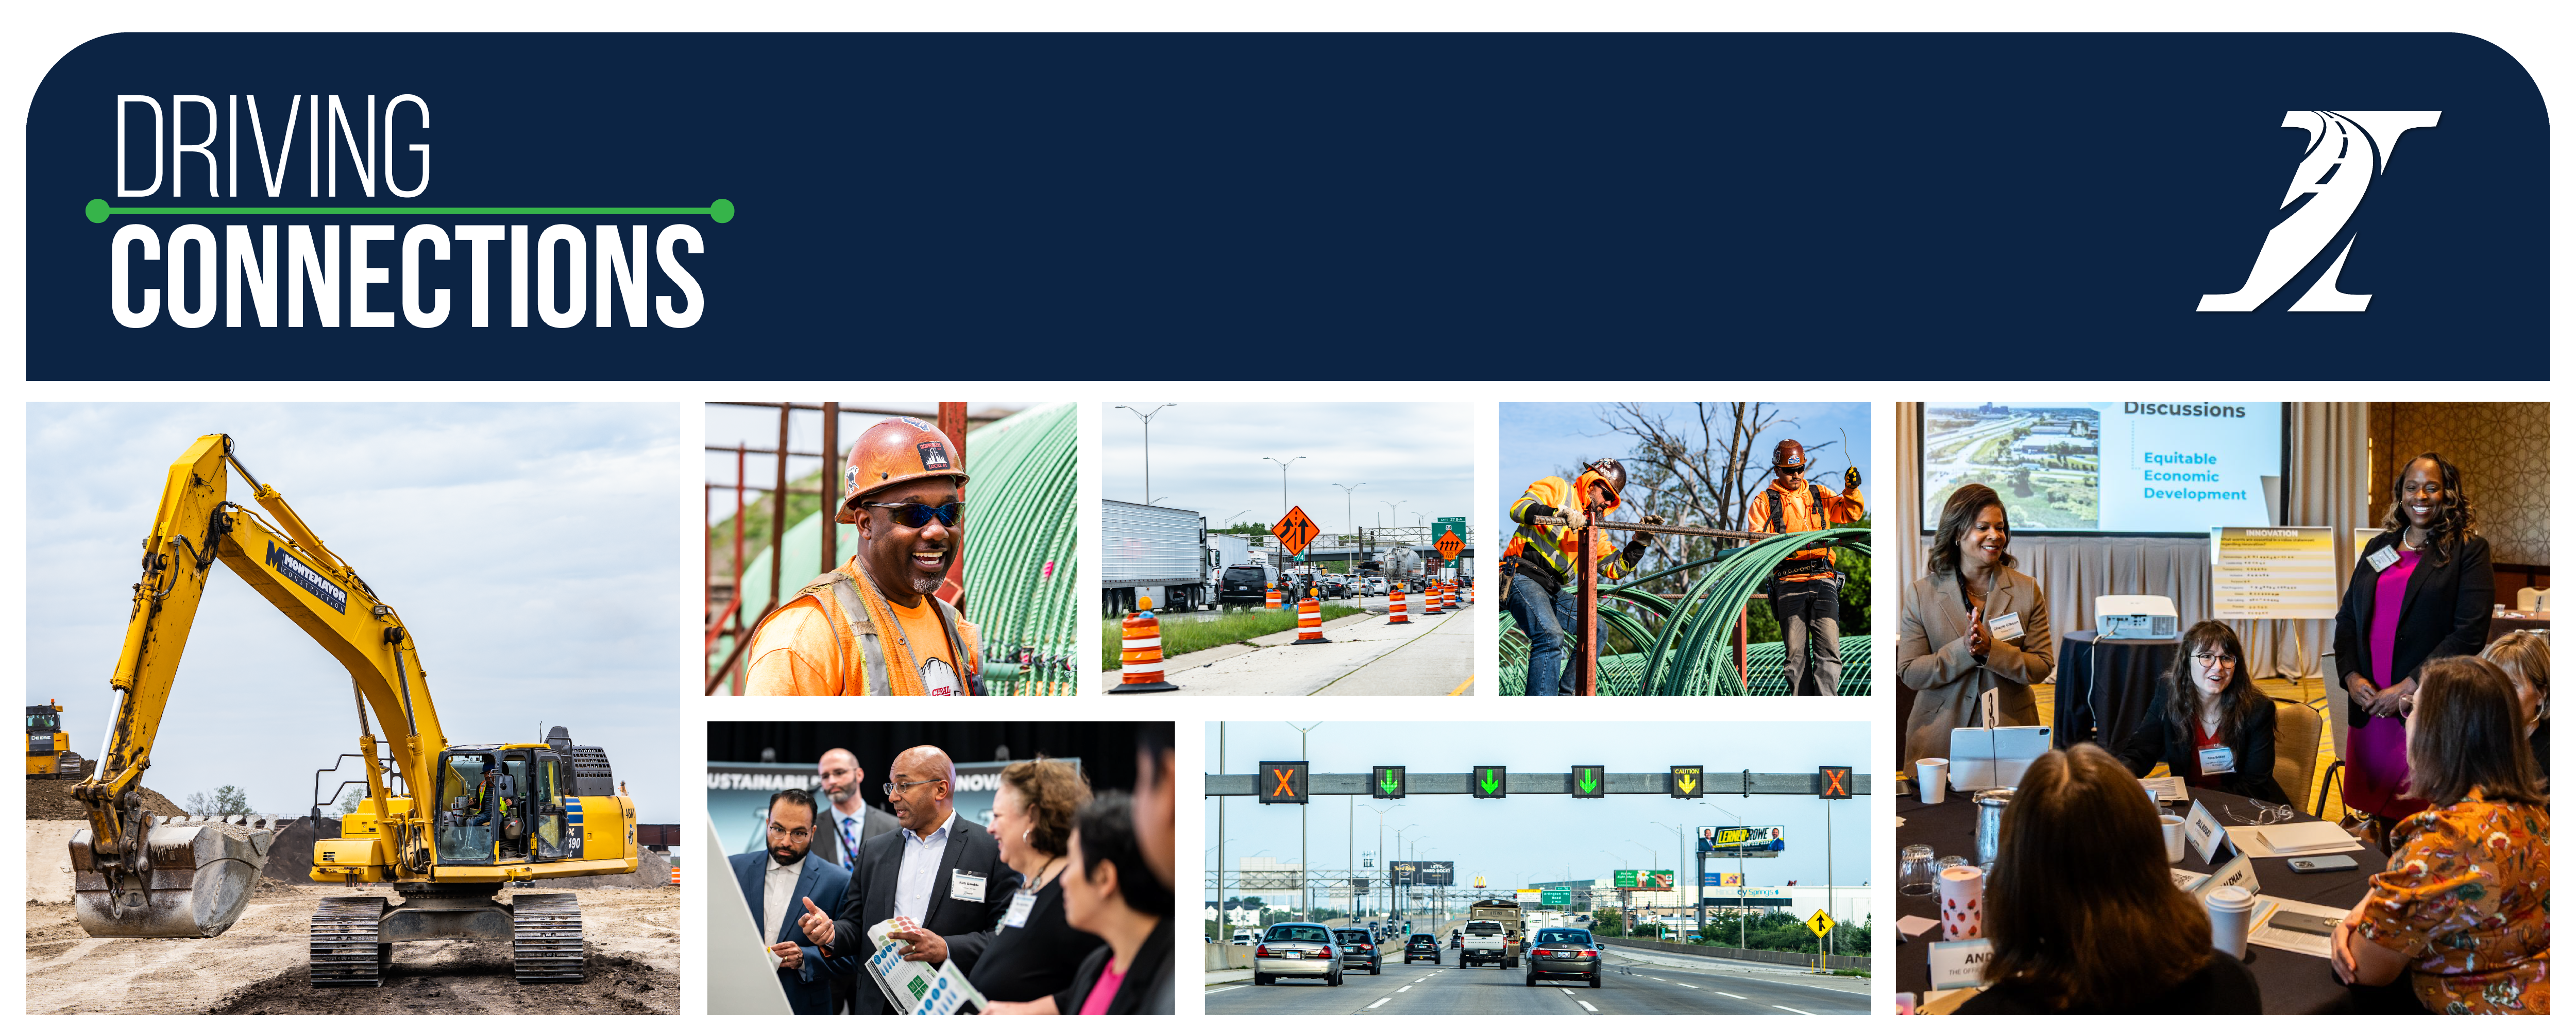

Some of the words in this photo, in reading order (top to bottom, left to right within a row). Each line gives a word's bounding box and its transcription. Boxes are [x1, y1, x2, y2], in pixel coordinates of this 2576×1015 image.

[2125, 402, 2246, 418] Discussions
[2144, 452, 2217, 466] Equitable
[2144, 470, 2219, 482] Economic
[2144, 488, 2247, 502] Development
[284, 554, 346, 604] MONTEMAYOR
[283, 569, 344, 612] CONSTRUCTION
[1988, 693, 1993, 717] 3
[625, 808, 635, 819] 48M
[1718, 830, 1747, 843] LERNER
[1749, 828, 1769, 840] ROWE
